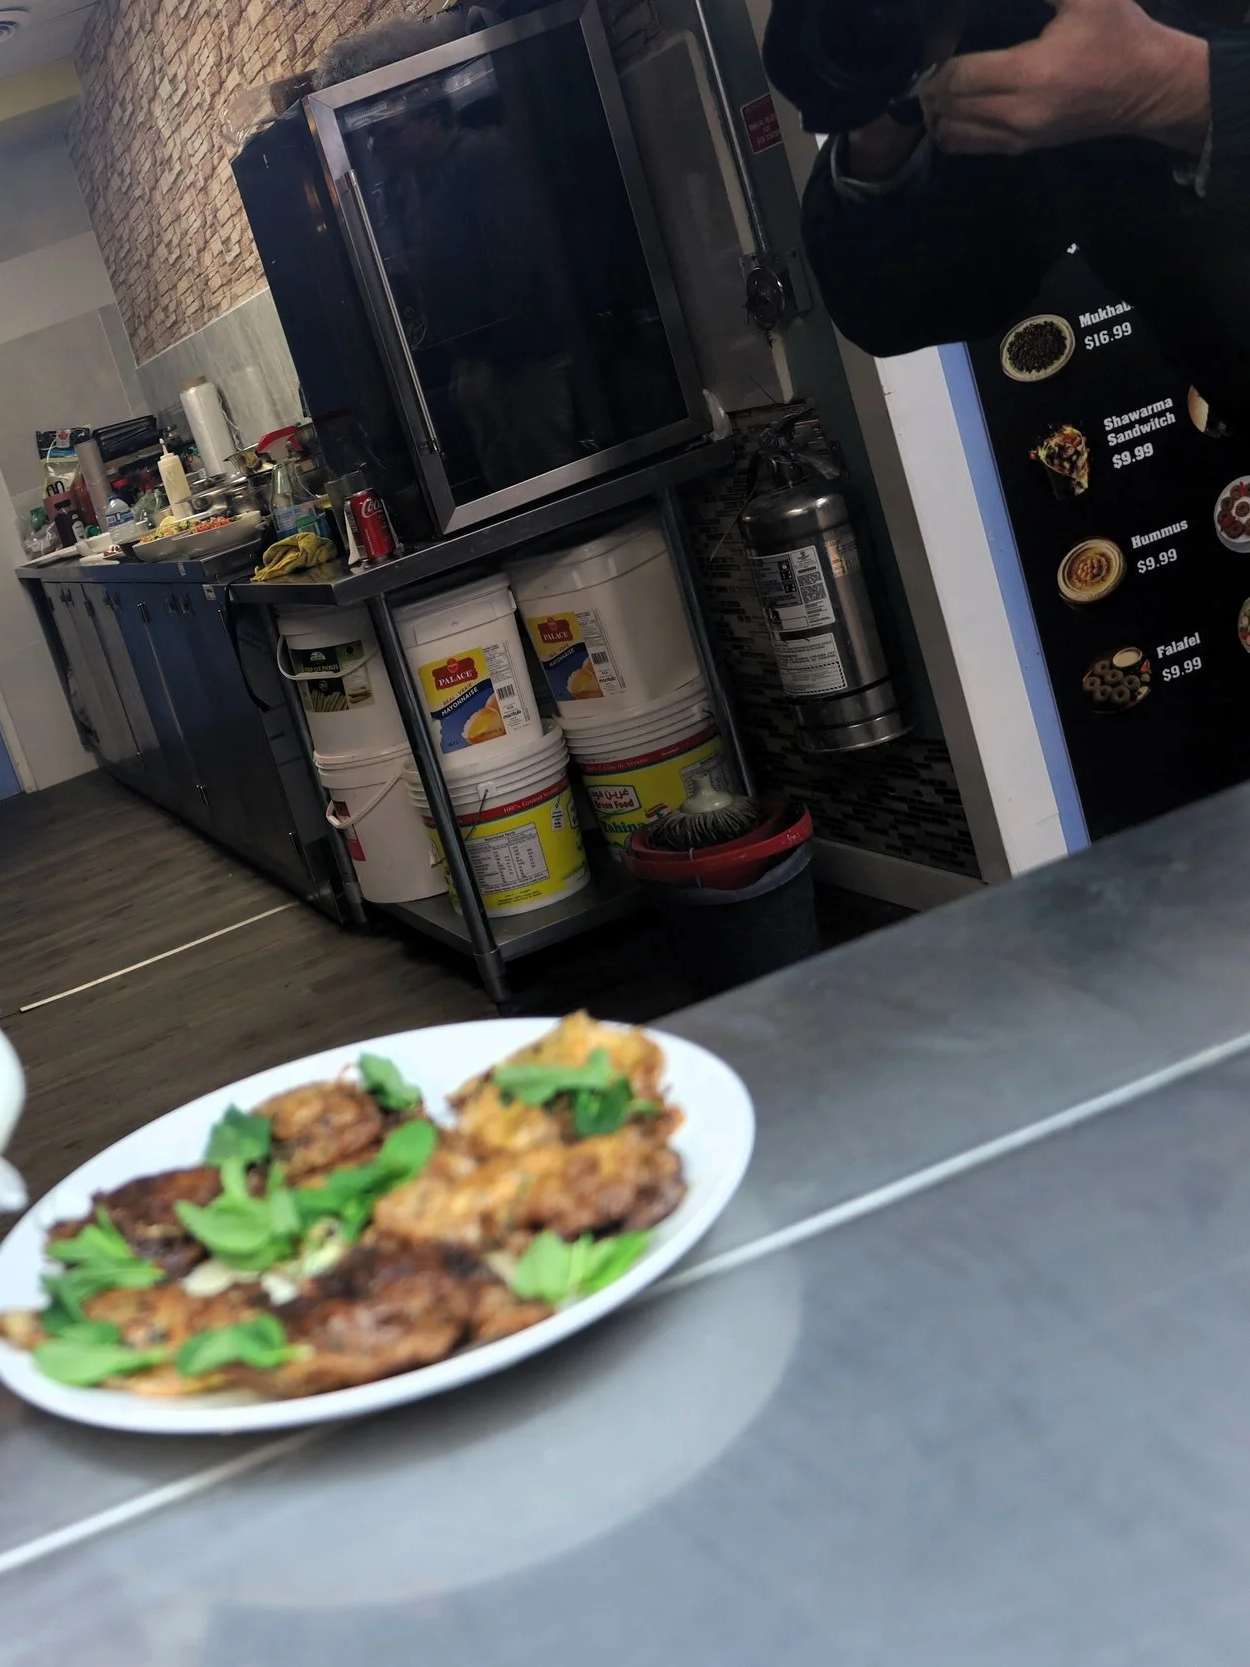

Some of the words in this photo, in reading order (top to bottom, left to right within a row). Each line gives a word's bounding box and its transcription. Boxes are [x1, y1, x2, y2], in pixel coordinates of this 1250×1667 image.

[1084, 321, 1132, 350] $16.99
[1103, 397, 1174, 431] Shawarma
[1107, 411, 1176, 447] Sandwitch
[1112, 442, 1154, 470] $9.99
[1131, 519, 1189, 549] Hummus
[1137, 548, 1178, 574] $9.99
[542, 630, 570, 642] PALACE
[1156, 632, 1201, 659] Falafel
[438, 669, 473, 687] PALACE
[1162, 656, 1203, 682] $9.99
[441, 686, 479, 718] MAYONNAISE
[614, 798, 635, 810] Food
